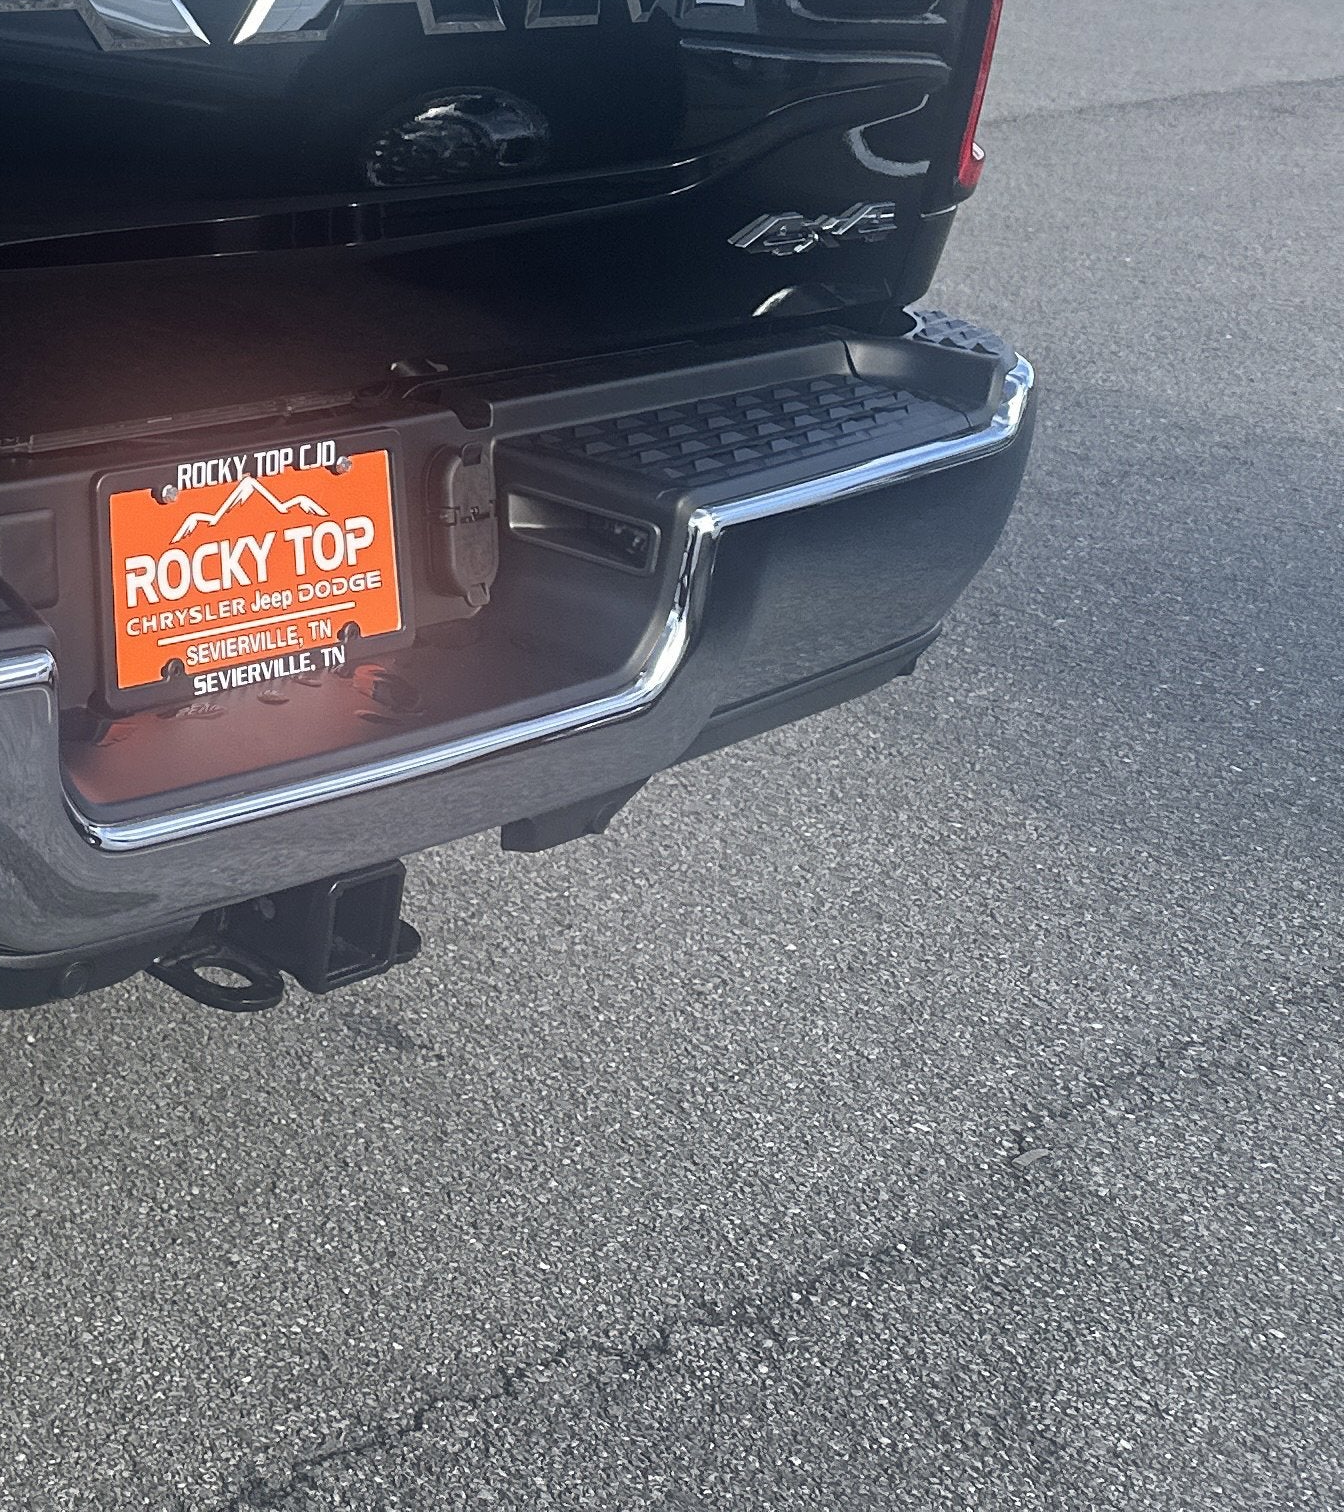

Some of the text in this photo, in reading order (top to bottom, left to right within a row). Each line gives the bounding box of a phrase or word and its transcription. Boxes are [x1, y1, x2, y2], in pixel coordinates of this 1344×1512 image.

[177, 440, 336, 490] ROCKY TOP CJD
[124, 516, 375, 608] ROCKY TOP
[125, 570, 382, 636] CHRYSLER Jeep DODGE
[186, 618, 332, 667] SEVIERVILLE, TN
[321, 645, 346, 667] TN
